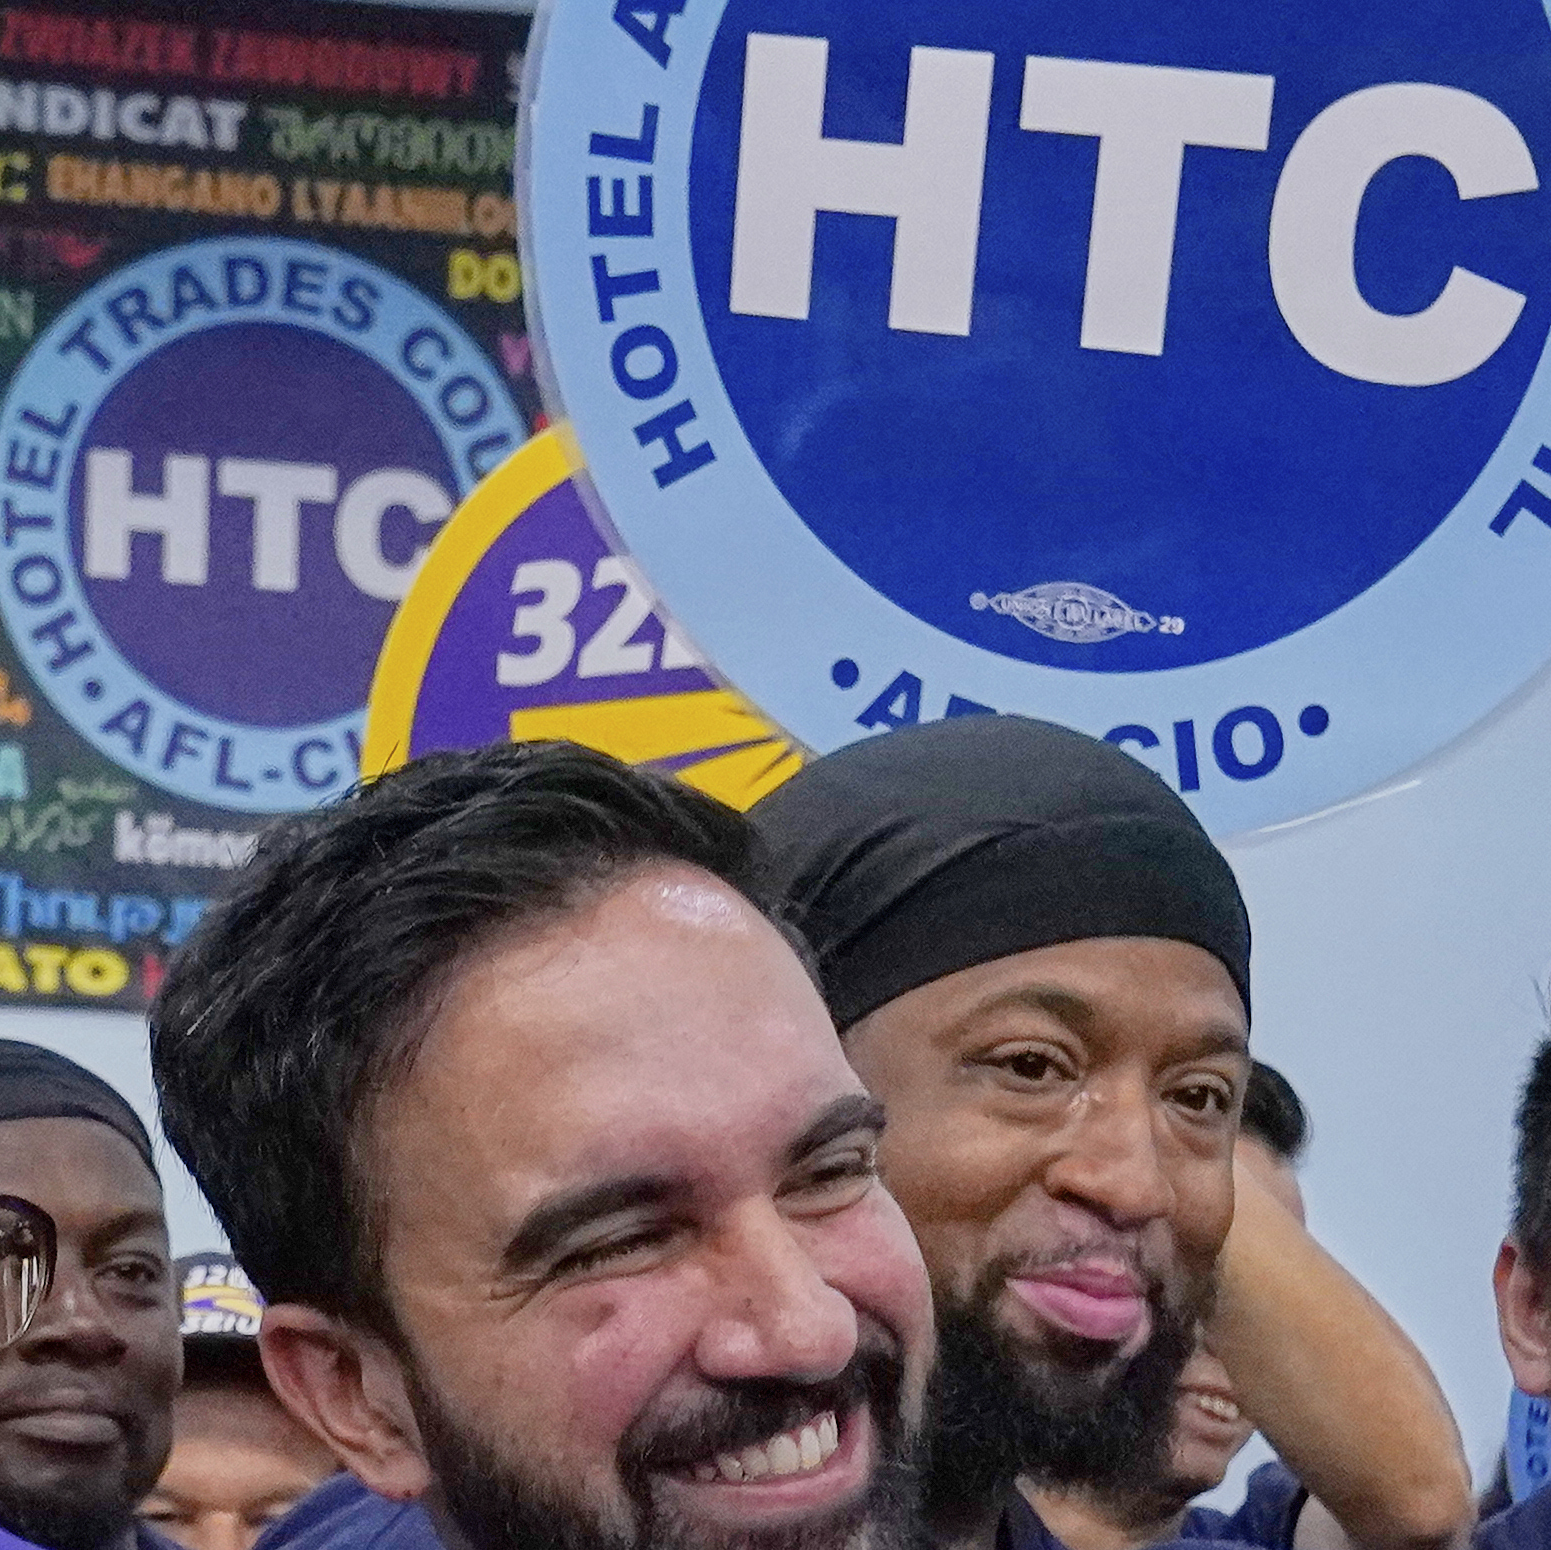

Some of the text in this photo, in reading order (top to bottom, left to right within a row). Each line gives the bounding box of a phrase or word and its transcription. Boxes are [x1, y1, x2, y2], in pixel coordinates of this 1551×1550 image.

[587, 102, 717, 490] HOTEL
[729, 31, 1541, 388] HTC
[4, 399, 96, 672] HOTEL
[56, 254, 383, 375] TRADES
[84, 446, 452, 602] HTC
